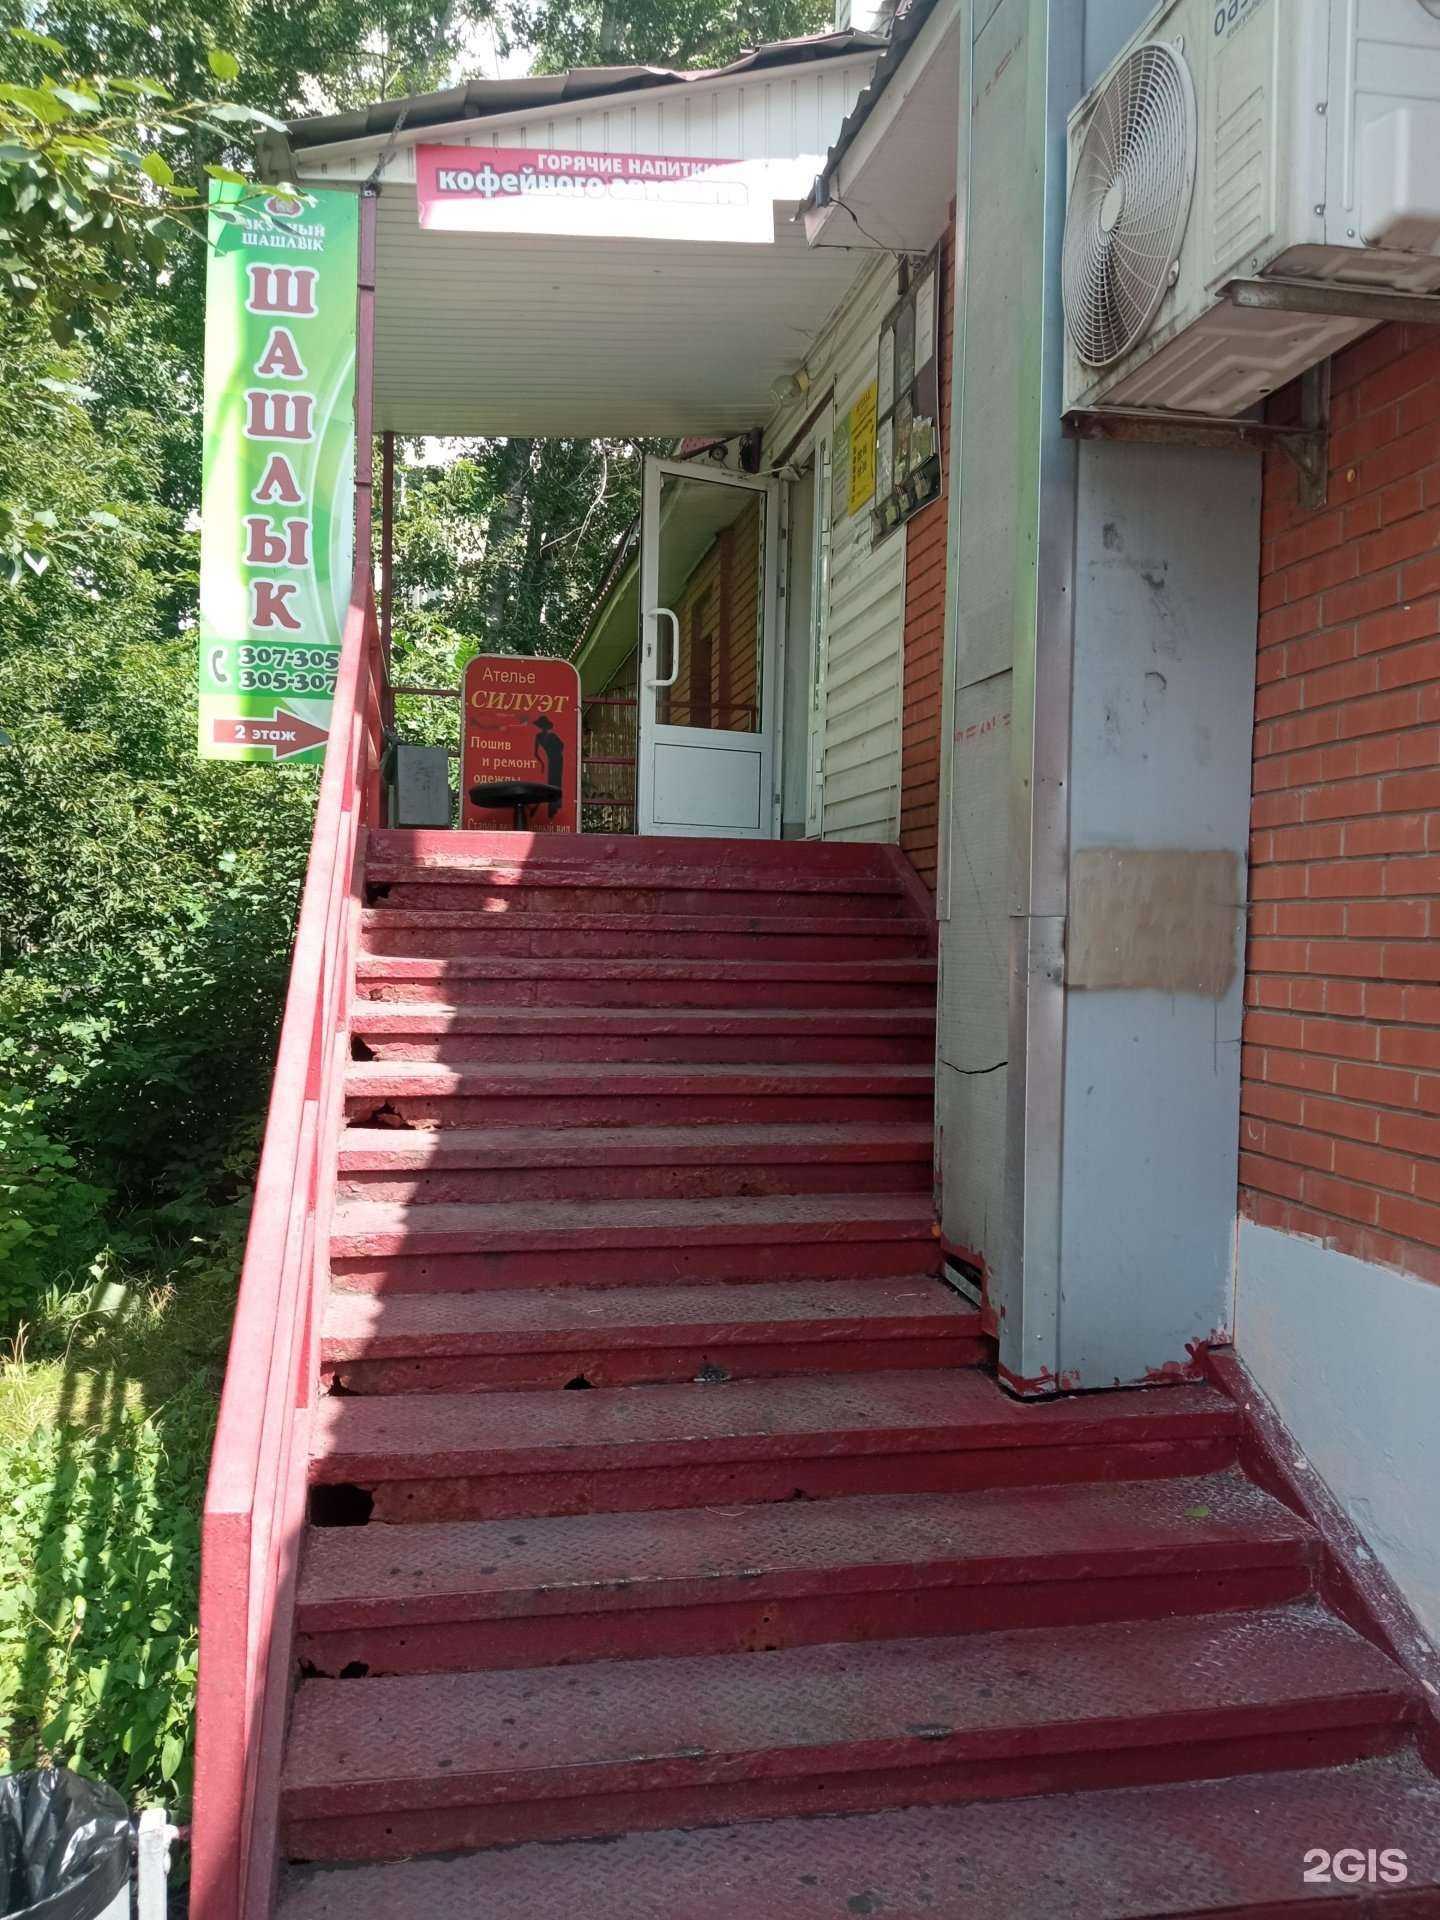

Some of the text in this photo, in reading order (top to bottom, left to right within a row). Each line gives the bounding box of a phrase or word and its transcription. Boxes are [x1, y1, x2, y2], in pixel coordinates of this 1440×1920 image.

[537, 153, 622, 173] ГОРЯЧИЕ
[241, 232, 324, 251] ШАШЛЫК
[246, 264, 318, 631] ШАШЛЫК
[240, 646, 340, 670] 307-305
[240, 669, 338, 694] 305-307
[482, 667, 536, 684] Ателье
[471, 690, 569, 713] СИЛУЭТ
[234, 724, 296, 741] 2 этаж
[471, 736, 512, 750] Пошив
[482, 757, 537, 770] и ремонт
